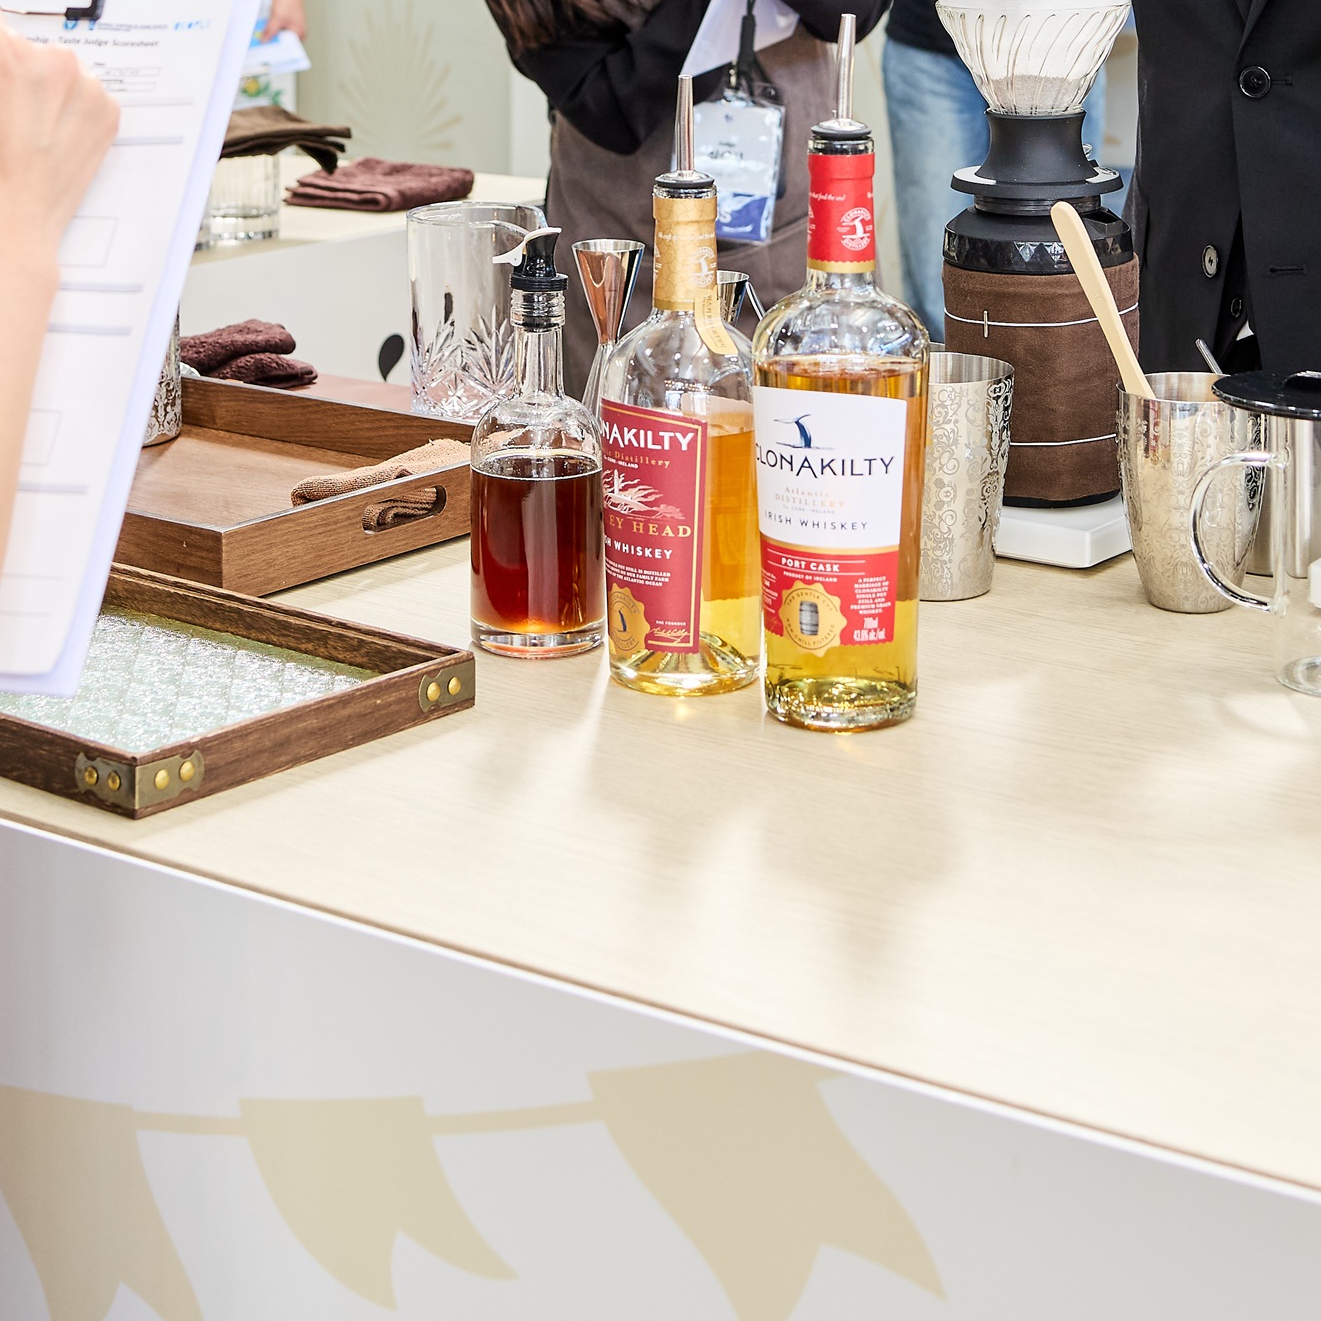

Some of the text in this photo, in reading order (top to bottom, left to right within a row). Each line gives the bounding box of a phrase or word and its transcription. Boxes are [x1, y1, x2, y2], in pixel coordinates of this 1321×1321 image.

[601, 419, 695, 451] NAKILTY
[614, 450, 670, 468] Distillery
[775, 493, 846, 508] DISTILLERY
[783, 486, 831, 498] Atlantic
[764, 509, 868, 530] IRISH WHISKEY
[632, 520, 692, 538] HEAD
[613, 540, 673, 560] WHISKEY
[781, 557, 841, 573] PORT CASK
[783, 570, 838, 583] PRODUCT OF IRELAND
[786, 591, 834, 611] THE GENTLE CUT
